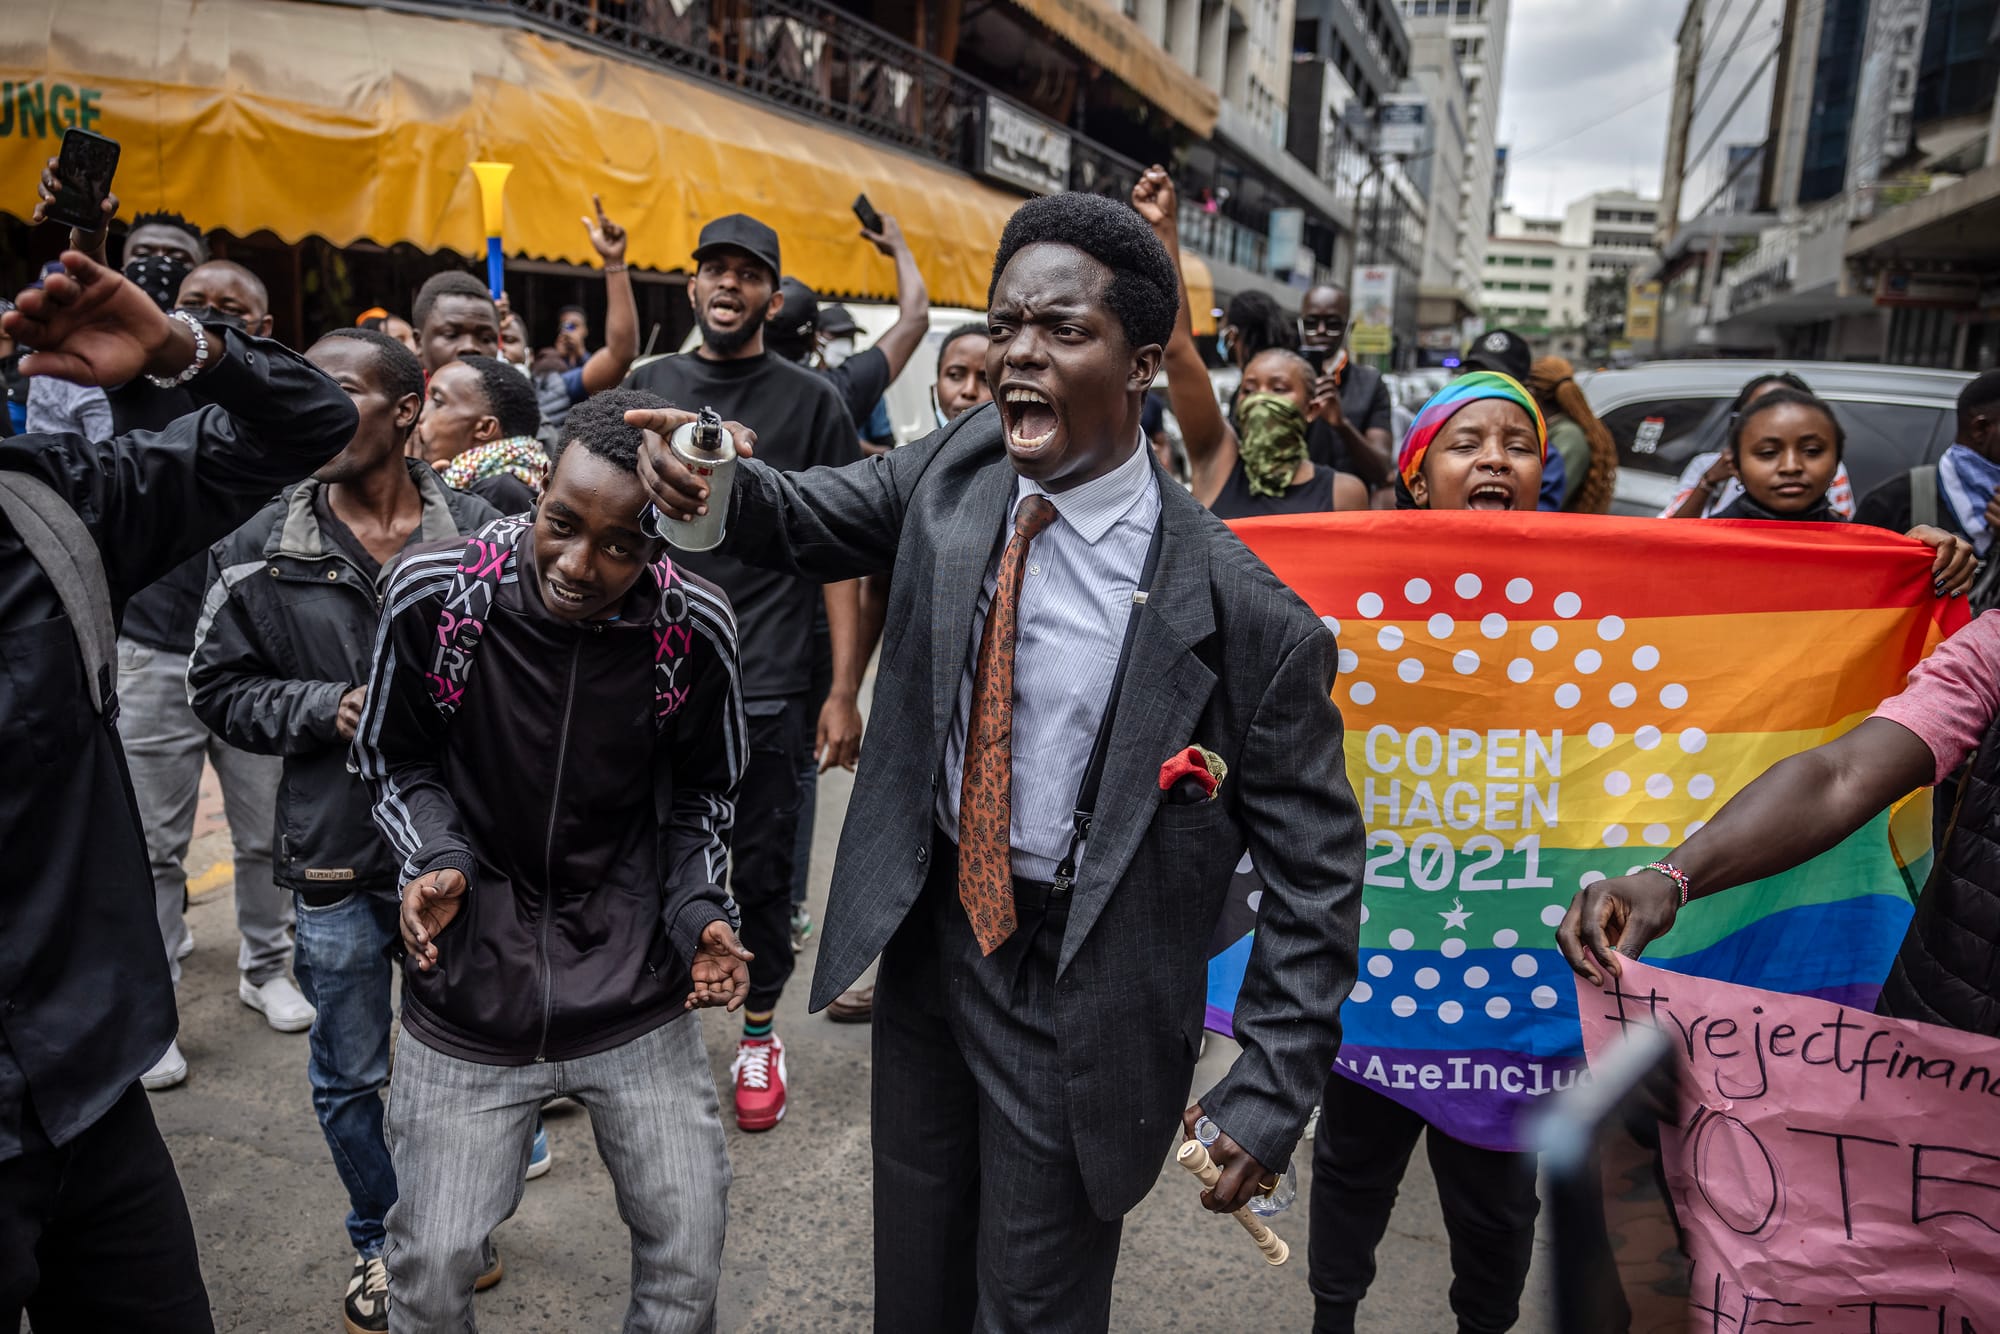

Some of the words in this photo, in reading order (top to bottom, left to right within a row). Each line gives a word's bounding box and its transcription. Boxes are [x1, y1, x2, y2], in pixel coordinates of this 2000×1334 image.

[1364, 723, 1563, 778] COPEN
[1363, 777, 1560, 831] HAGEN
[1363, 829, 1554, 892] 2021
